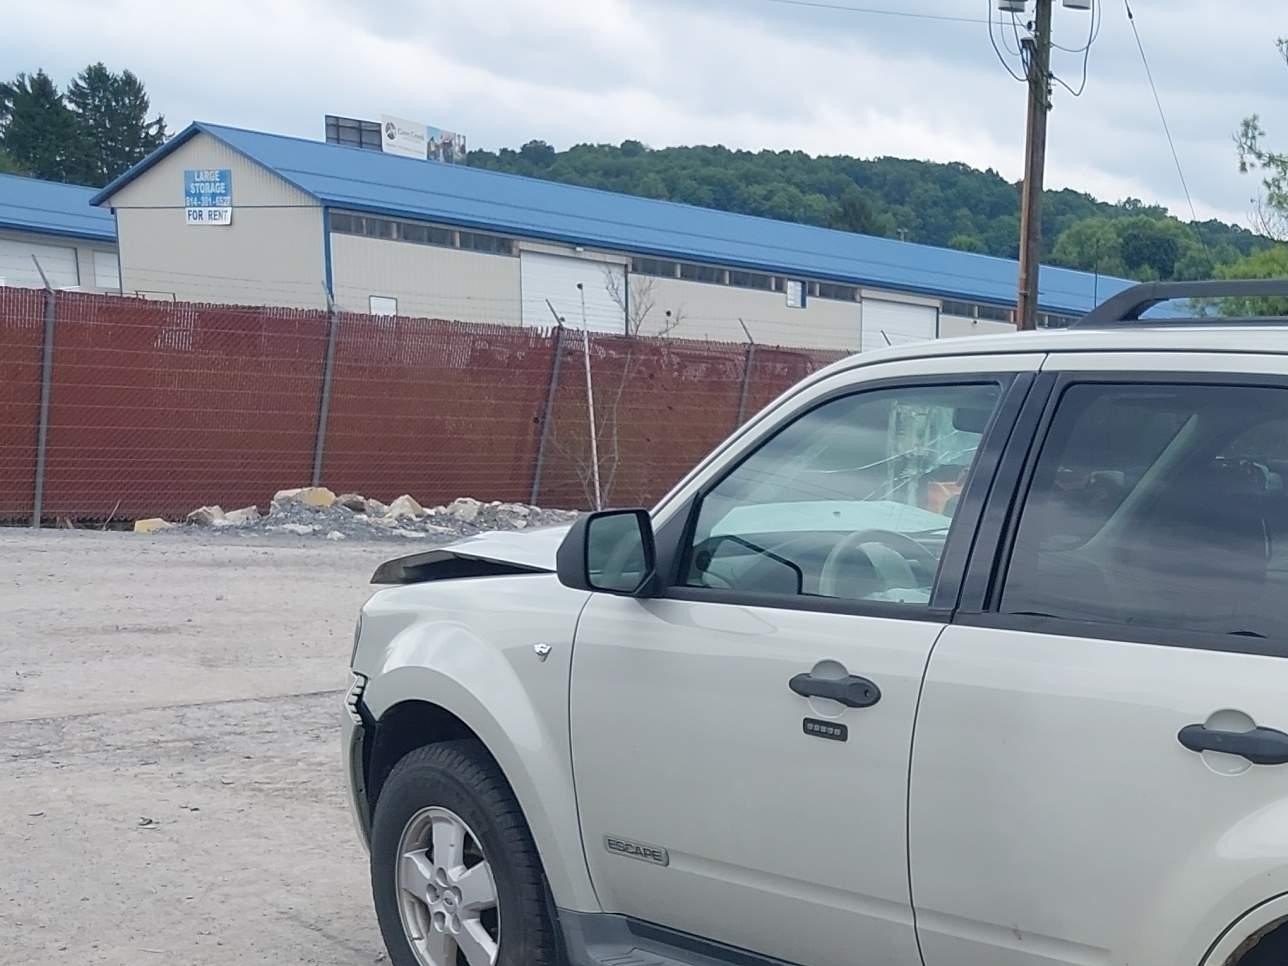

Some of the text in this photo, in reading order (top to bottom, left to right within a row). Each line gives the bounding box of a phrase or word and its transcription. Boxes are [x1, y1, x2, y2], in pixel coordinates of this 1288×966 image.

[194, 170, 221, 181] LARGE
[190, 182, 226, 194] STORAGE
[187, 210, 228, 220] FOR RENT
[607, 839, 663, 862] ESCAPE
